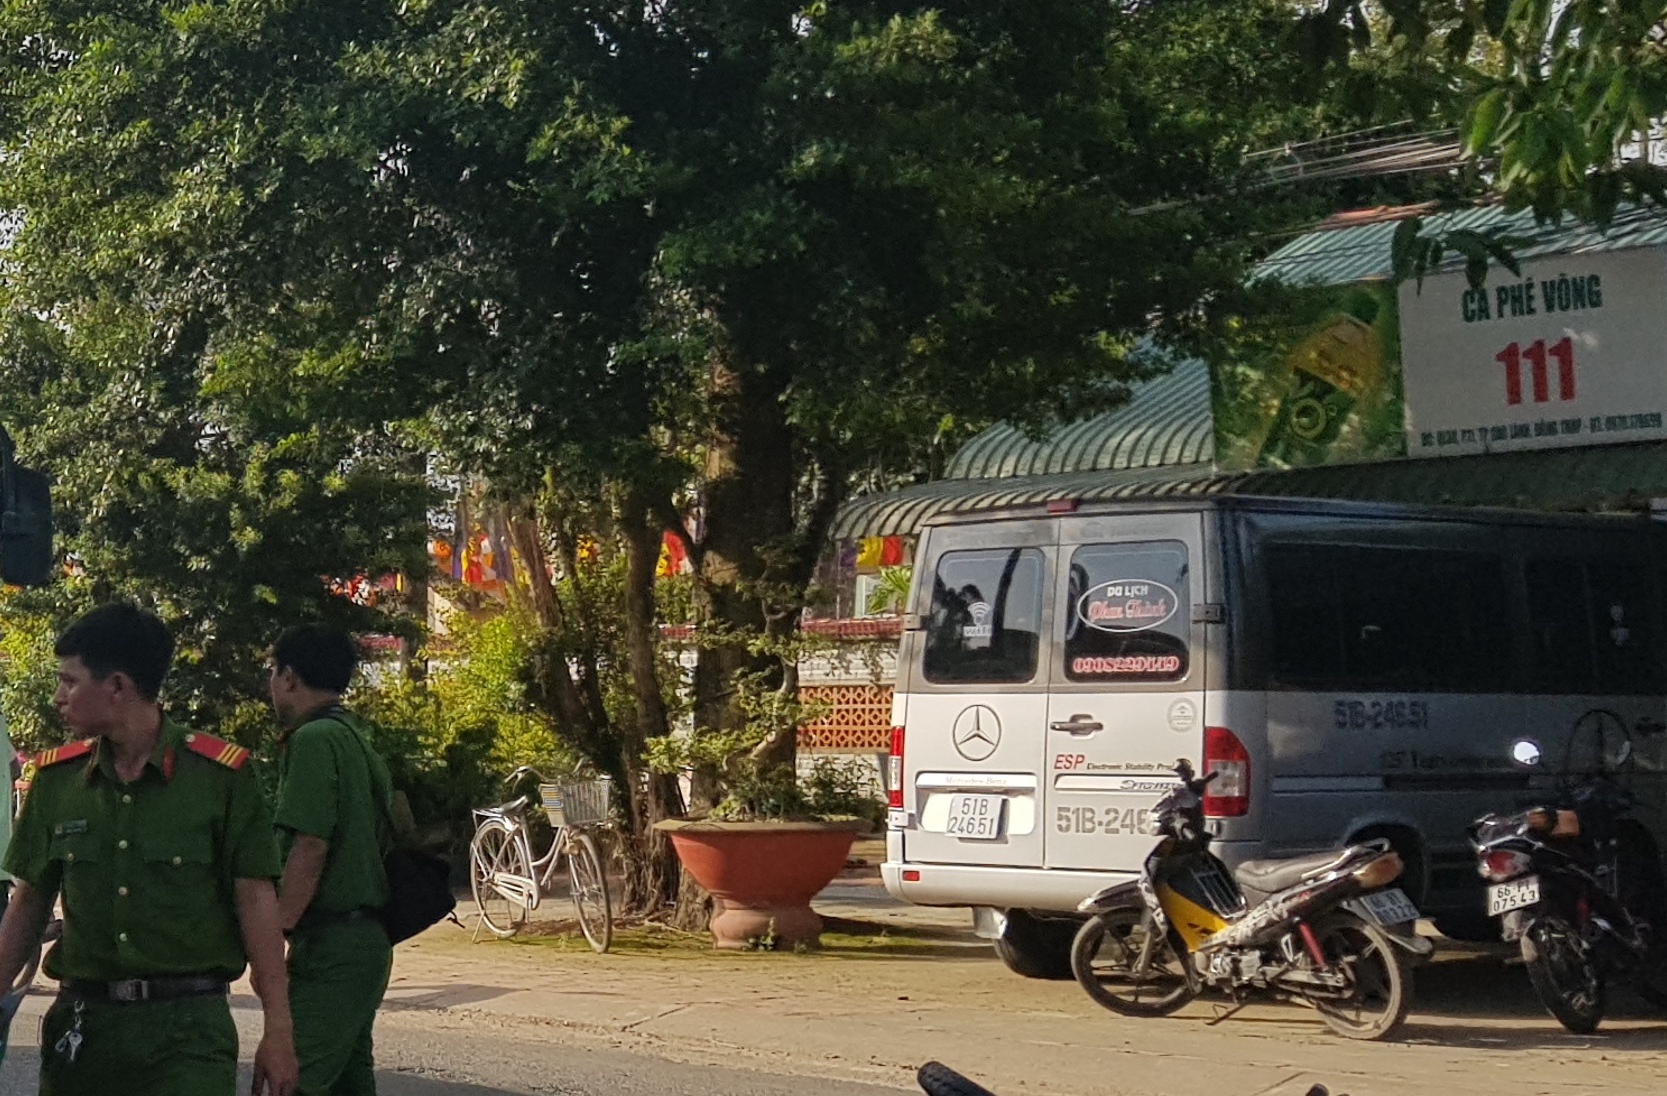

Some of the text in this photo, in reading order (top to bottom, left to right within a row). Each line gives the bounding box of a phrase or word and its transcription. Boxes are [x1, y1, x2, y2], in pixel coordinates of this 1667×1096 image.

[1495, 337, 1576, 405] 111
[1053, 754, 1085, 770] ESP
[961, 798, 988, 815] 51B
